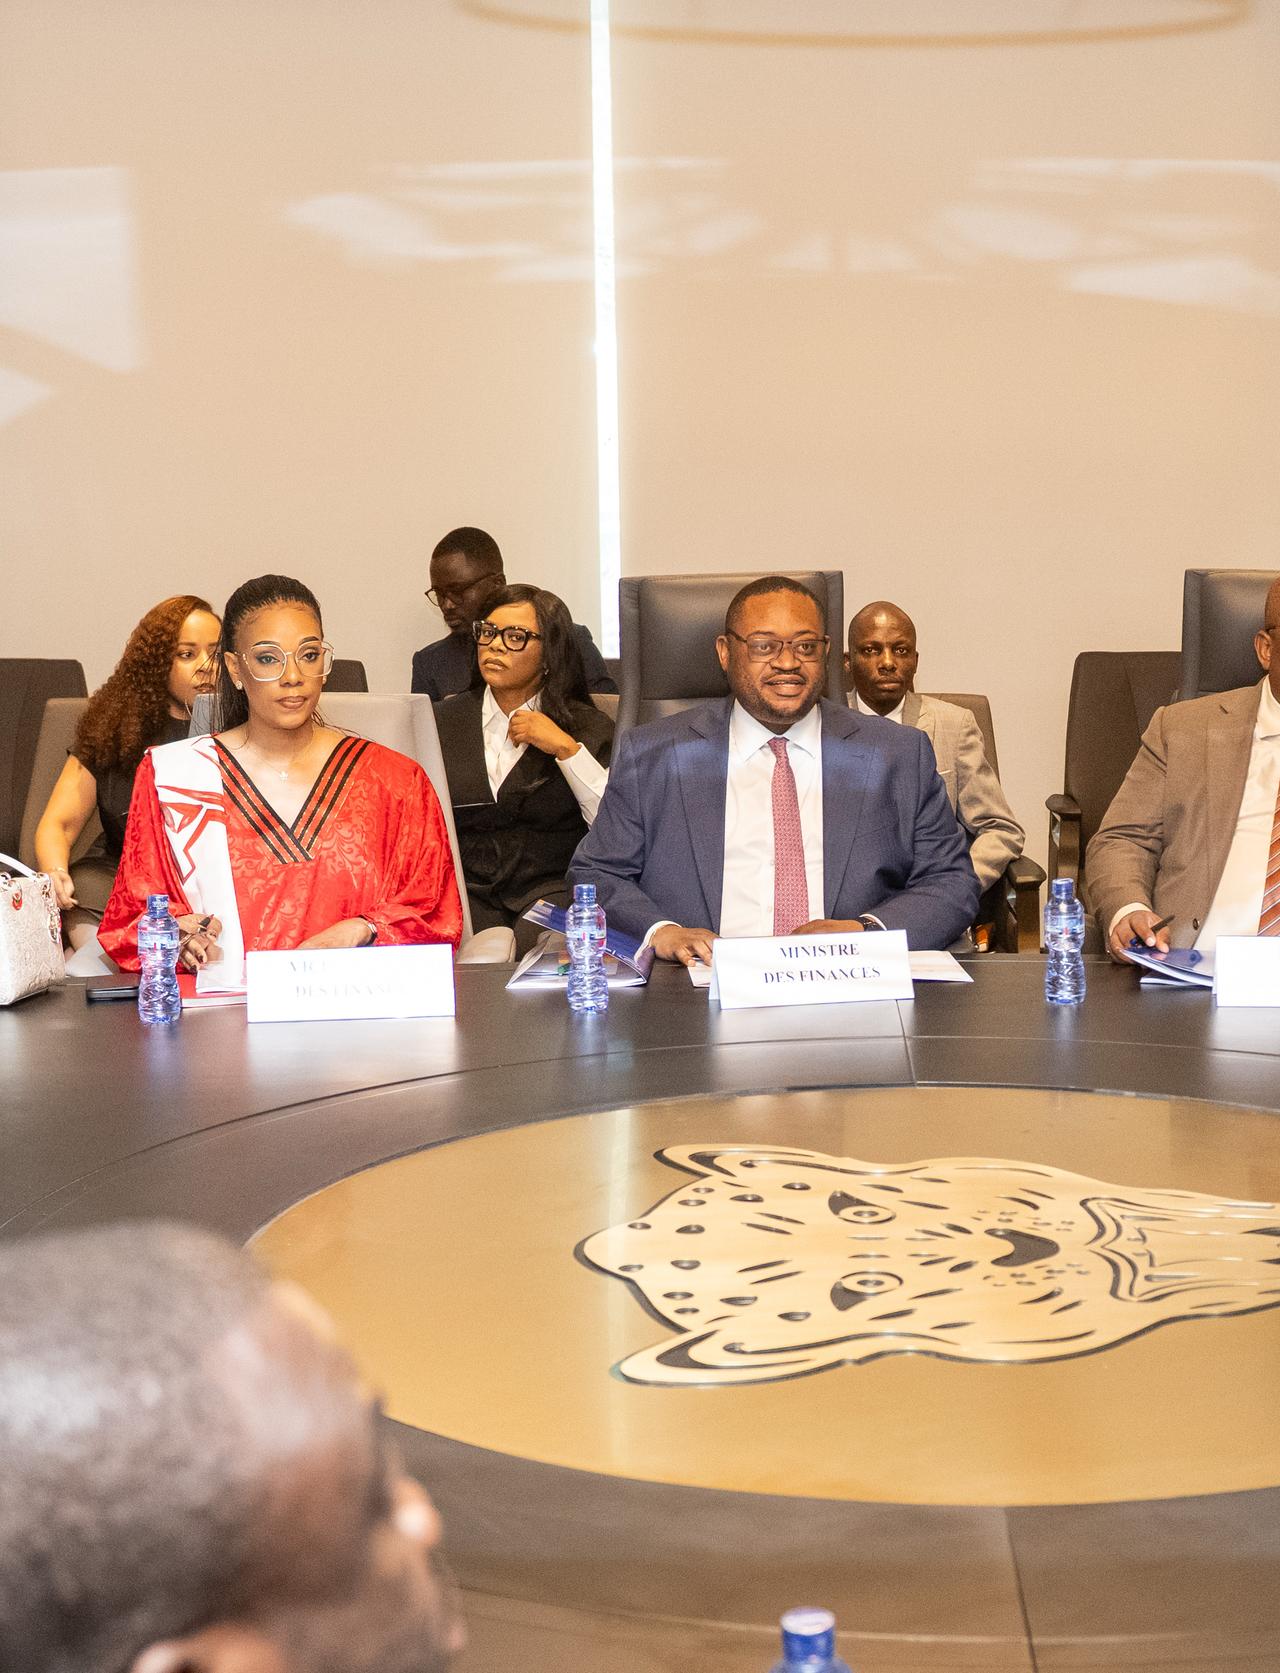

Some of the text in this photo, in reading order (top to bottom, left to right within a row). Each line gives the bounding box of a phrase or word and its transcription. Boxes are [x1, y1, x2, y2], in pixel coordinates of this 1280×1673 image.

[780, 944, 860, 959] MINISTRE
[764, 966, 881, 984] DES FINANCES
